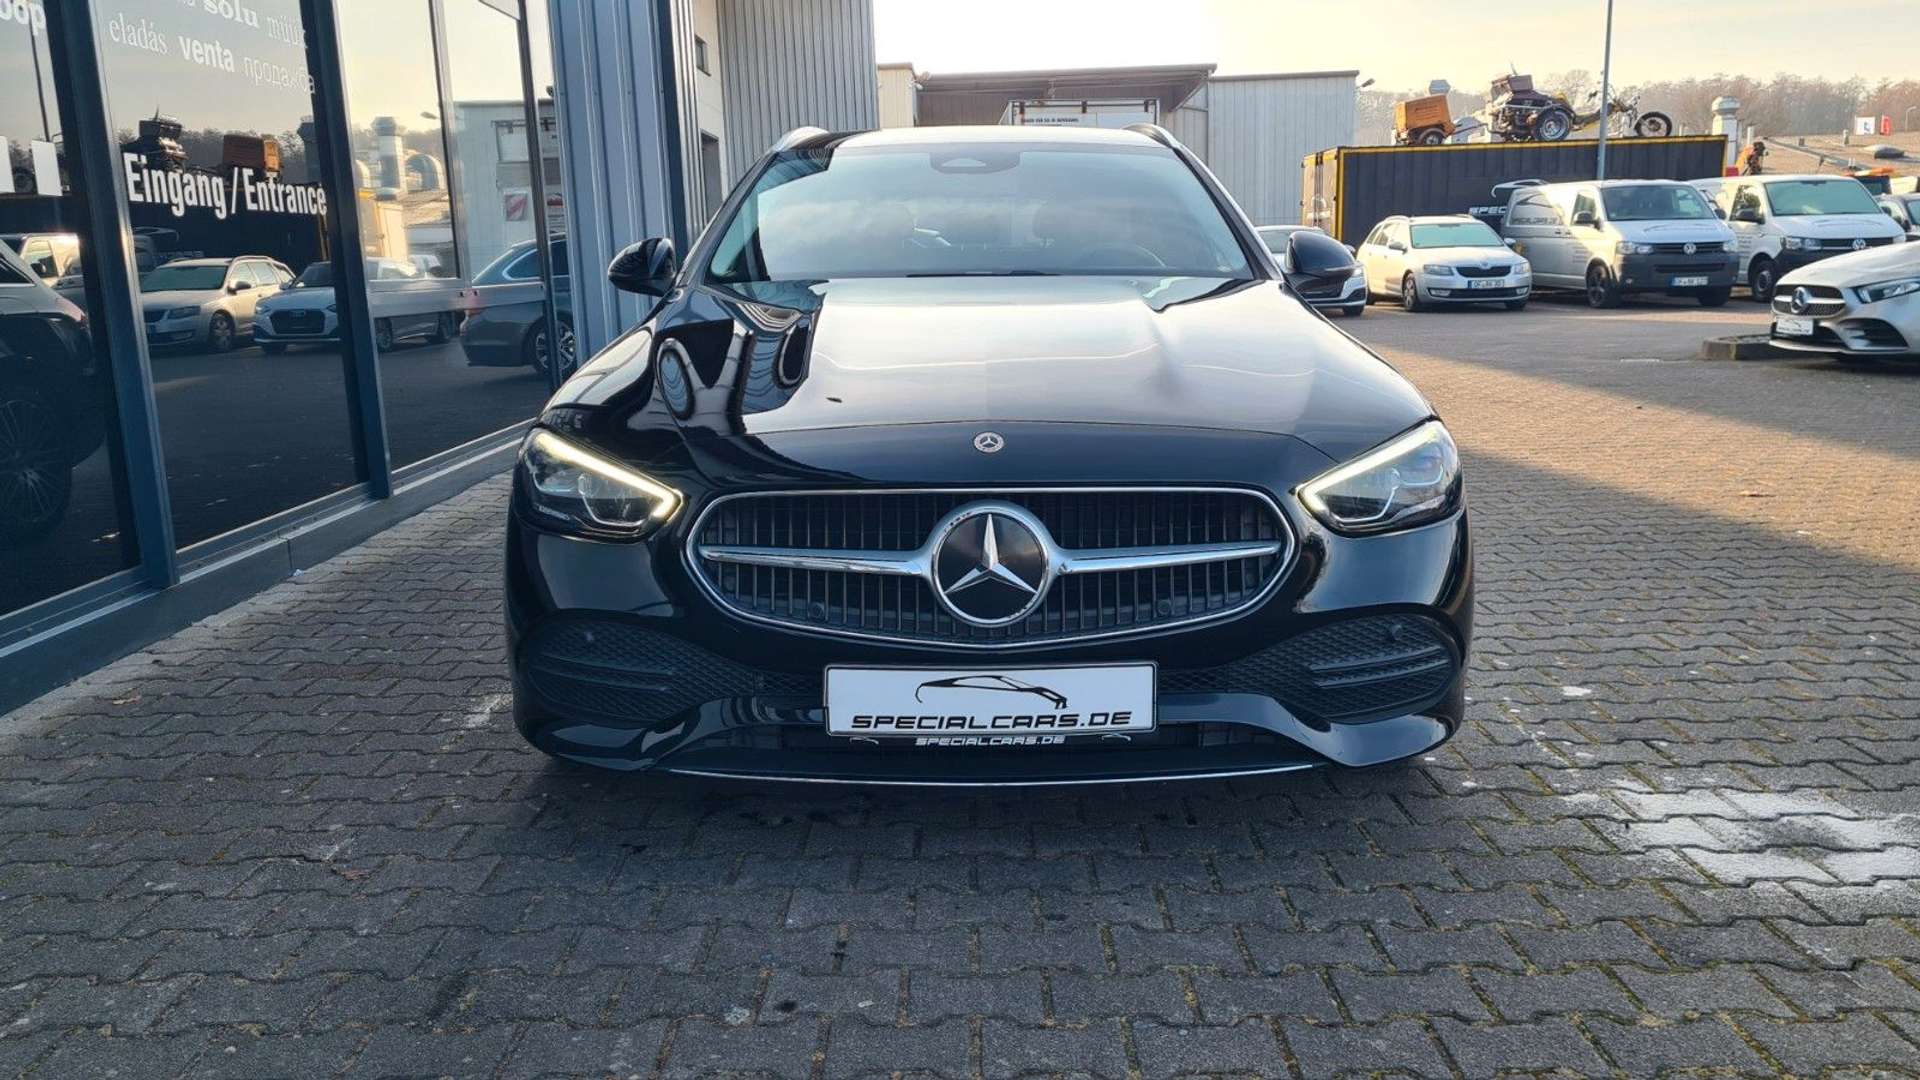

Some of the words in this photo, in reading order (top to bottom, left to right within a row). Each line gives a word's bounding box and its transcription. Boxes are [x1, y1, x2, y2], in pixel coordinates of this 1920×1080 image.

[109, 13, 167, 54] eladás
[178, 36, 235, 73] venta
[852, 711, 1132, 729] SPECIALCARS.DE
[915, 736, 1066, 747] SPECIALCARS.DE
